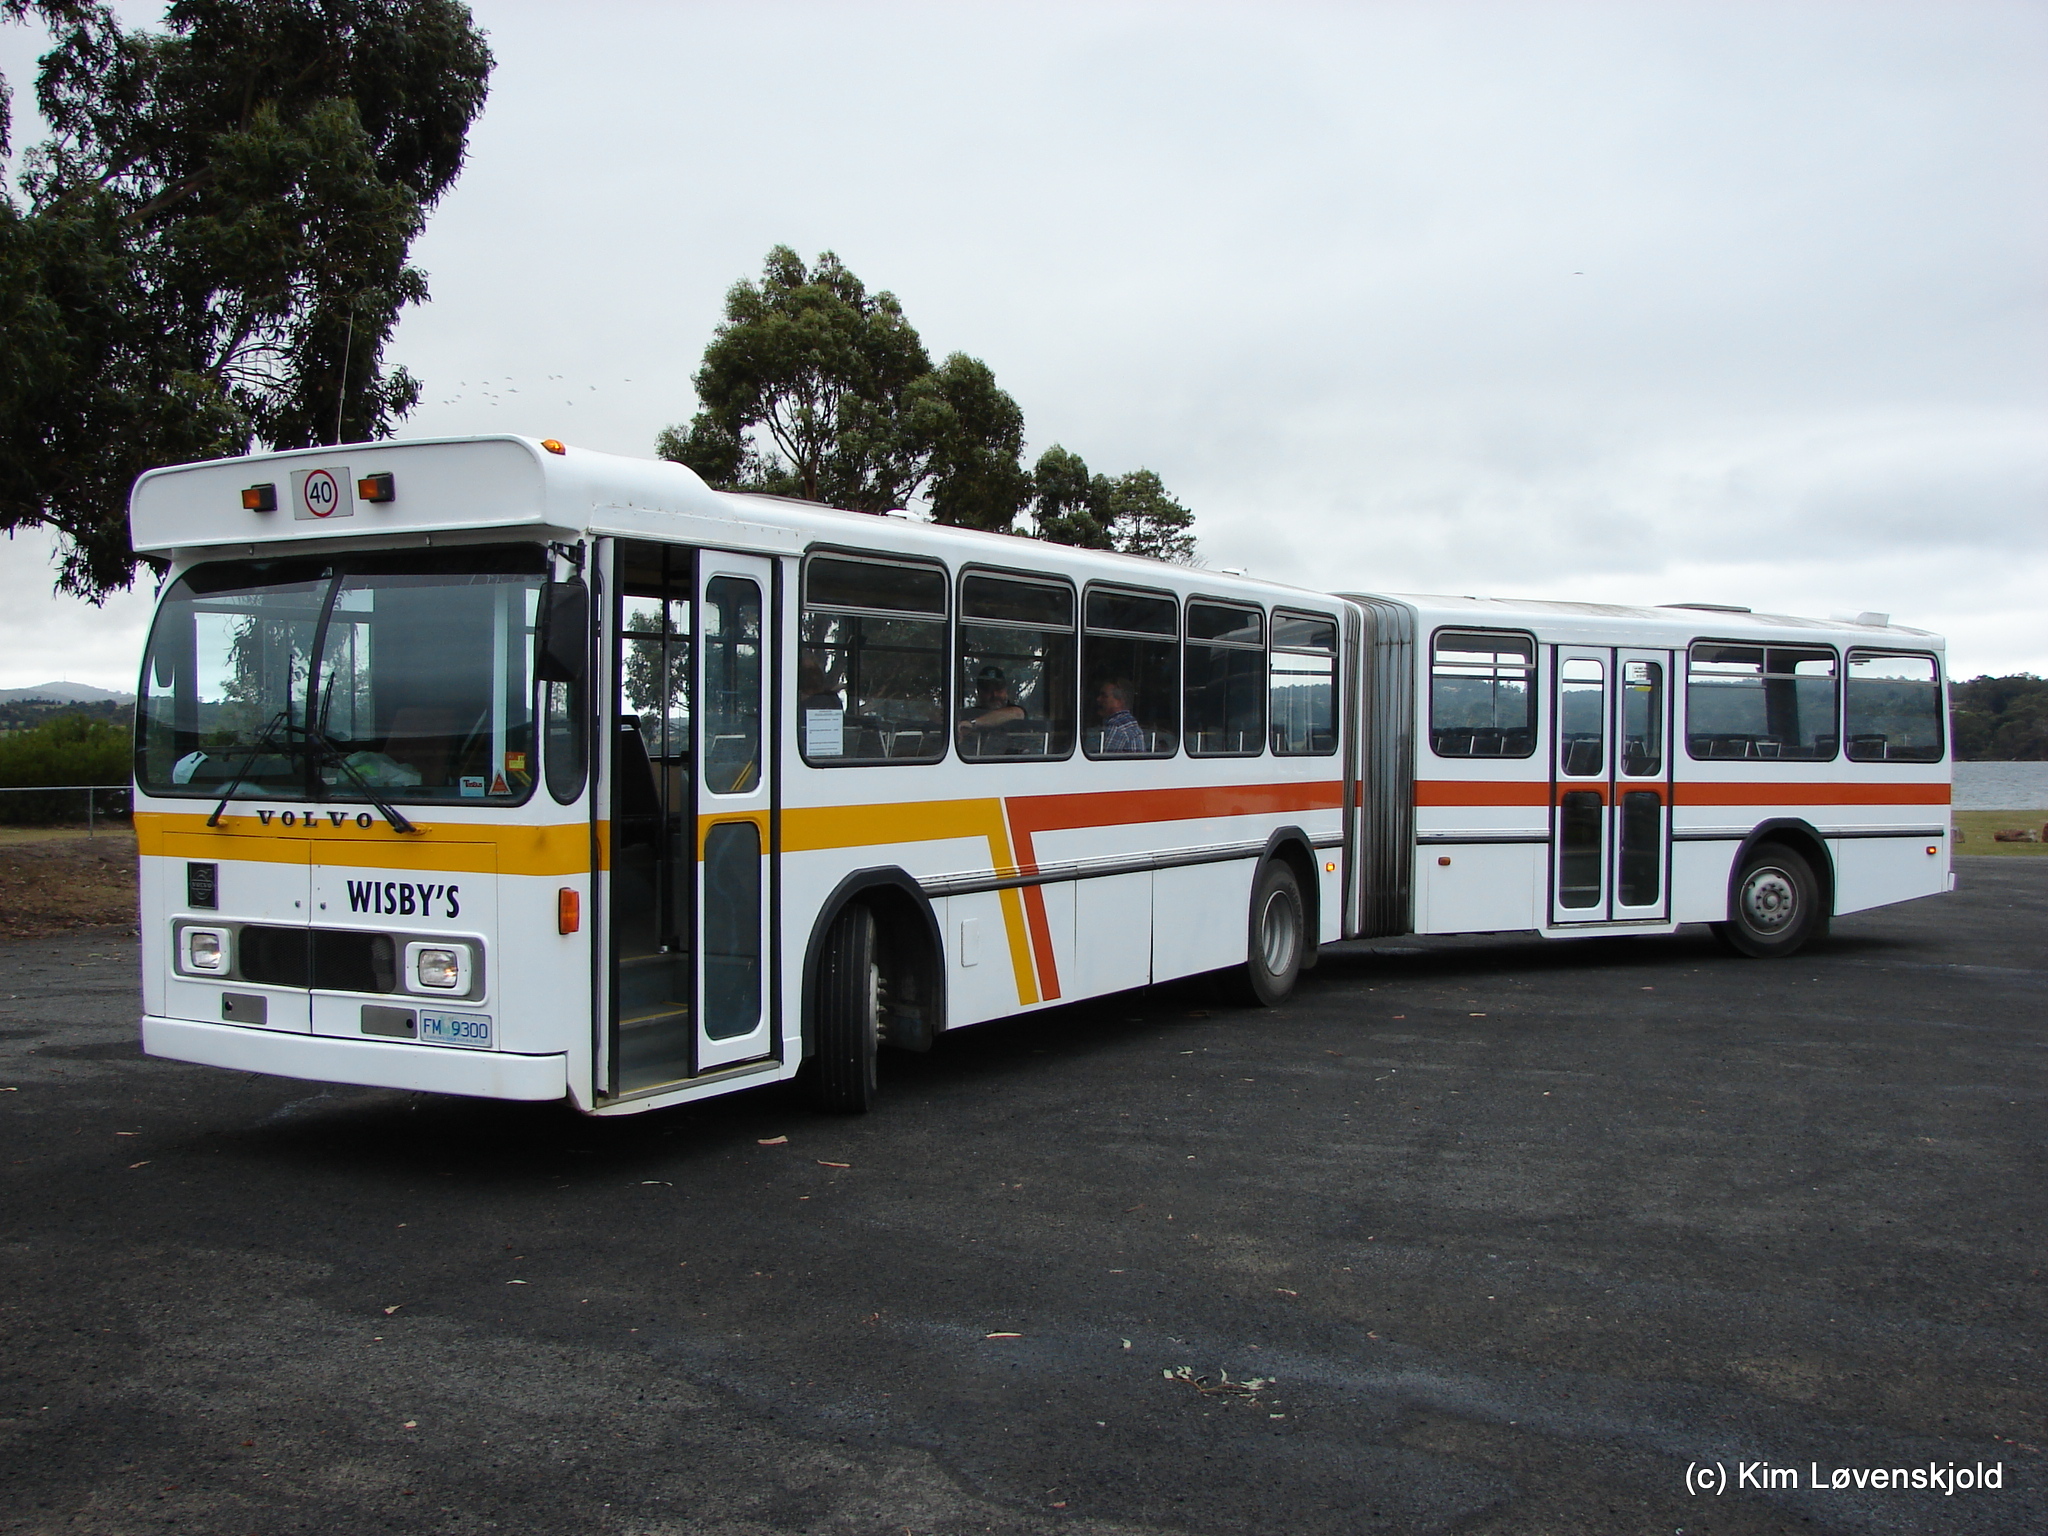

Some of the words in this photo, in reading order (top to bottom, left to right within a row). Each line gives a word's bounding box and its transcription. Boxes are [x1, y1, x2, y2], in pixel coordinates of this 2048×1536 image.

[309, 481, 332, 504] 40
[256, 809, 374, 830] VOLVO
[346, 880, 460, 919] WISBY'S
[423, 1018, 442, 1036] FM
[451, 1021, 489, 1040] 9300
